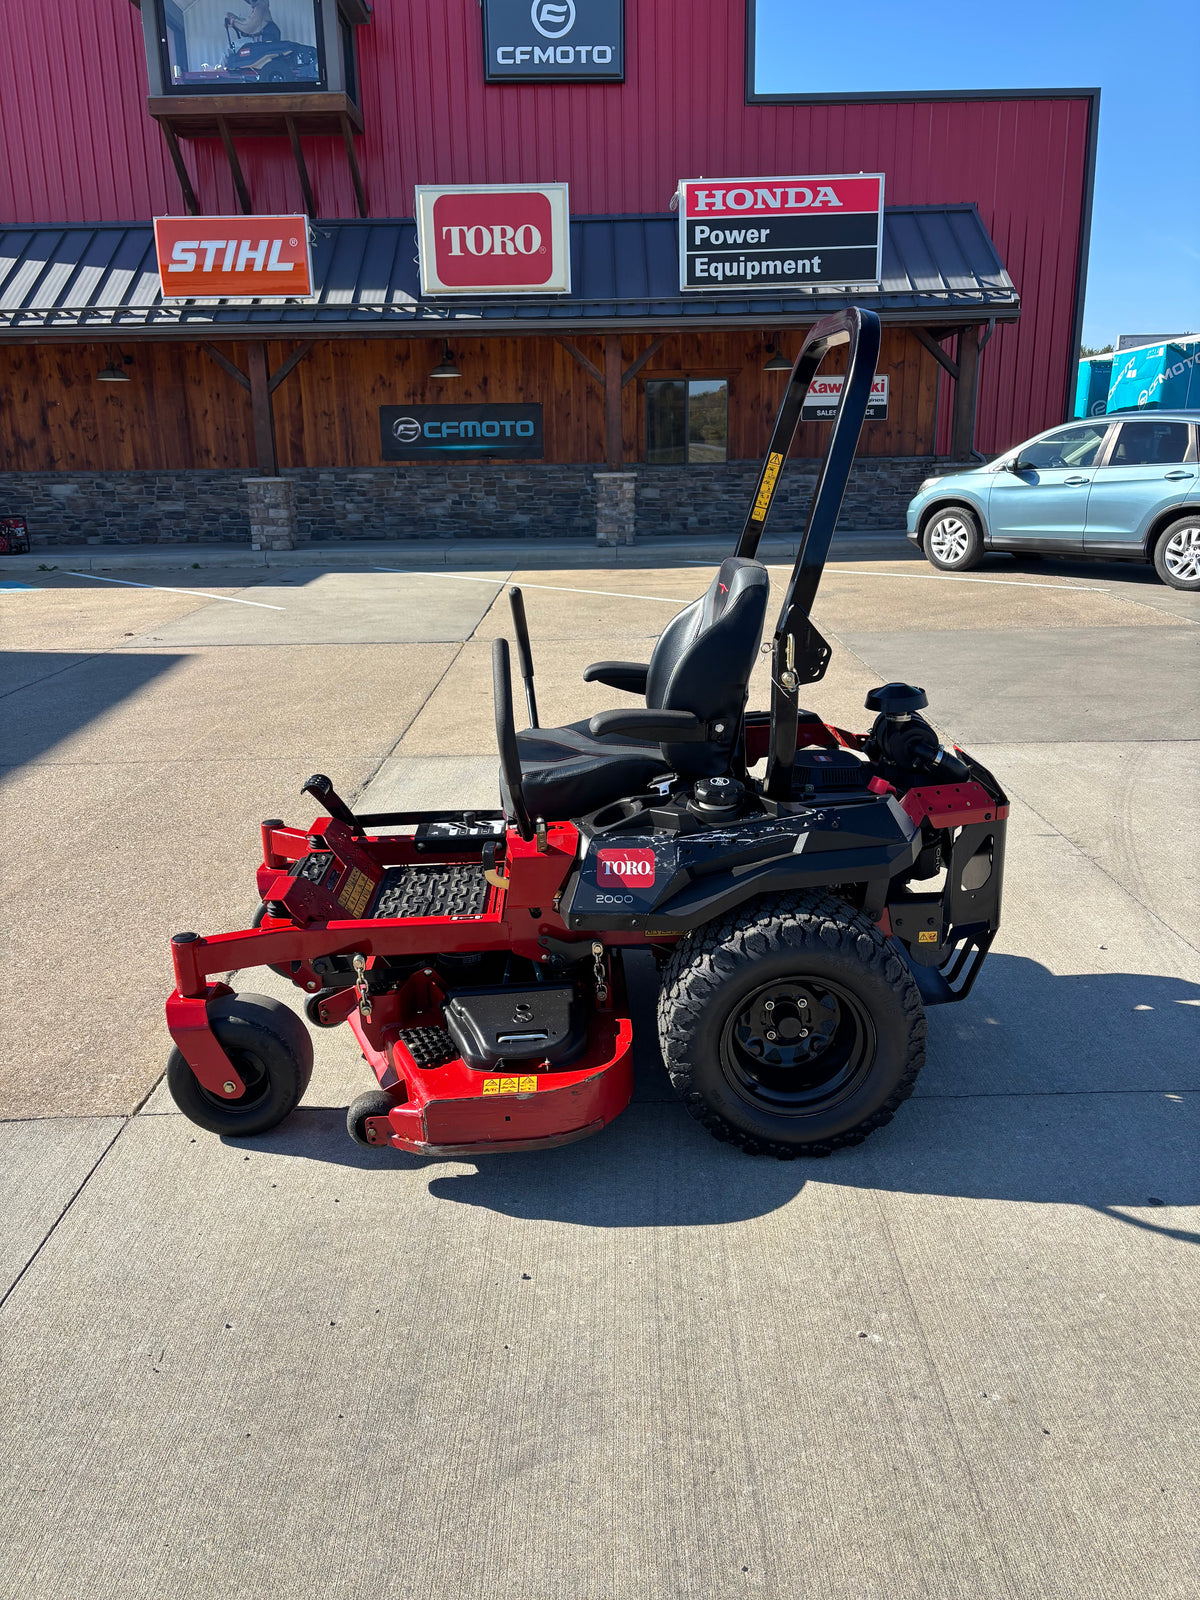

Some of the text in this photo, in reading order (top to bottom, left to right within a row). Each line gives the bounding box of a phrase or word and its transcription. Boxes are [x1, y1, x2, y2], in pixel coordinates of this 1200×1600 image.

[496, 45, 612, 65] CFMOTO
[694, 186, 843, 211] HONDA
[442, 224, 542, 256] TORO
[694, 225, 770, 246] Power
[167, 239, 295, 273] STIHL
[694, 256, 822, 281] Equipment
[807, 379, 886, 394] Kawki
[423, 420, 535, 438] CFMOTO
[602, 860, 651, 876] TORO
[595, 894, 634, 904] 2000
